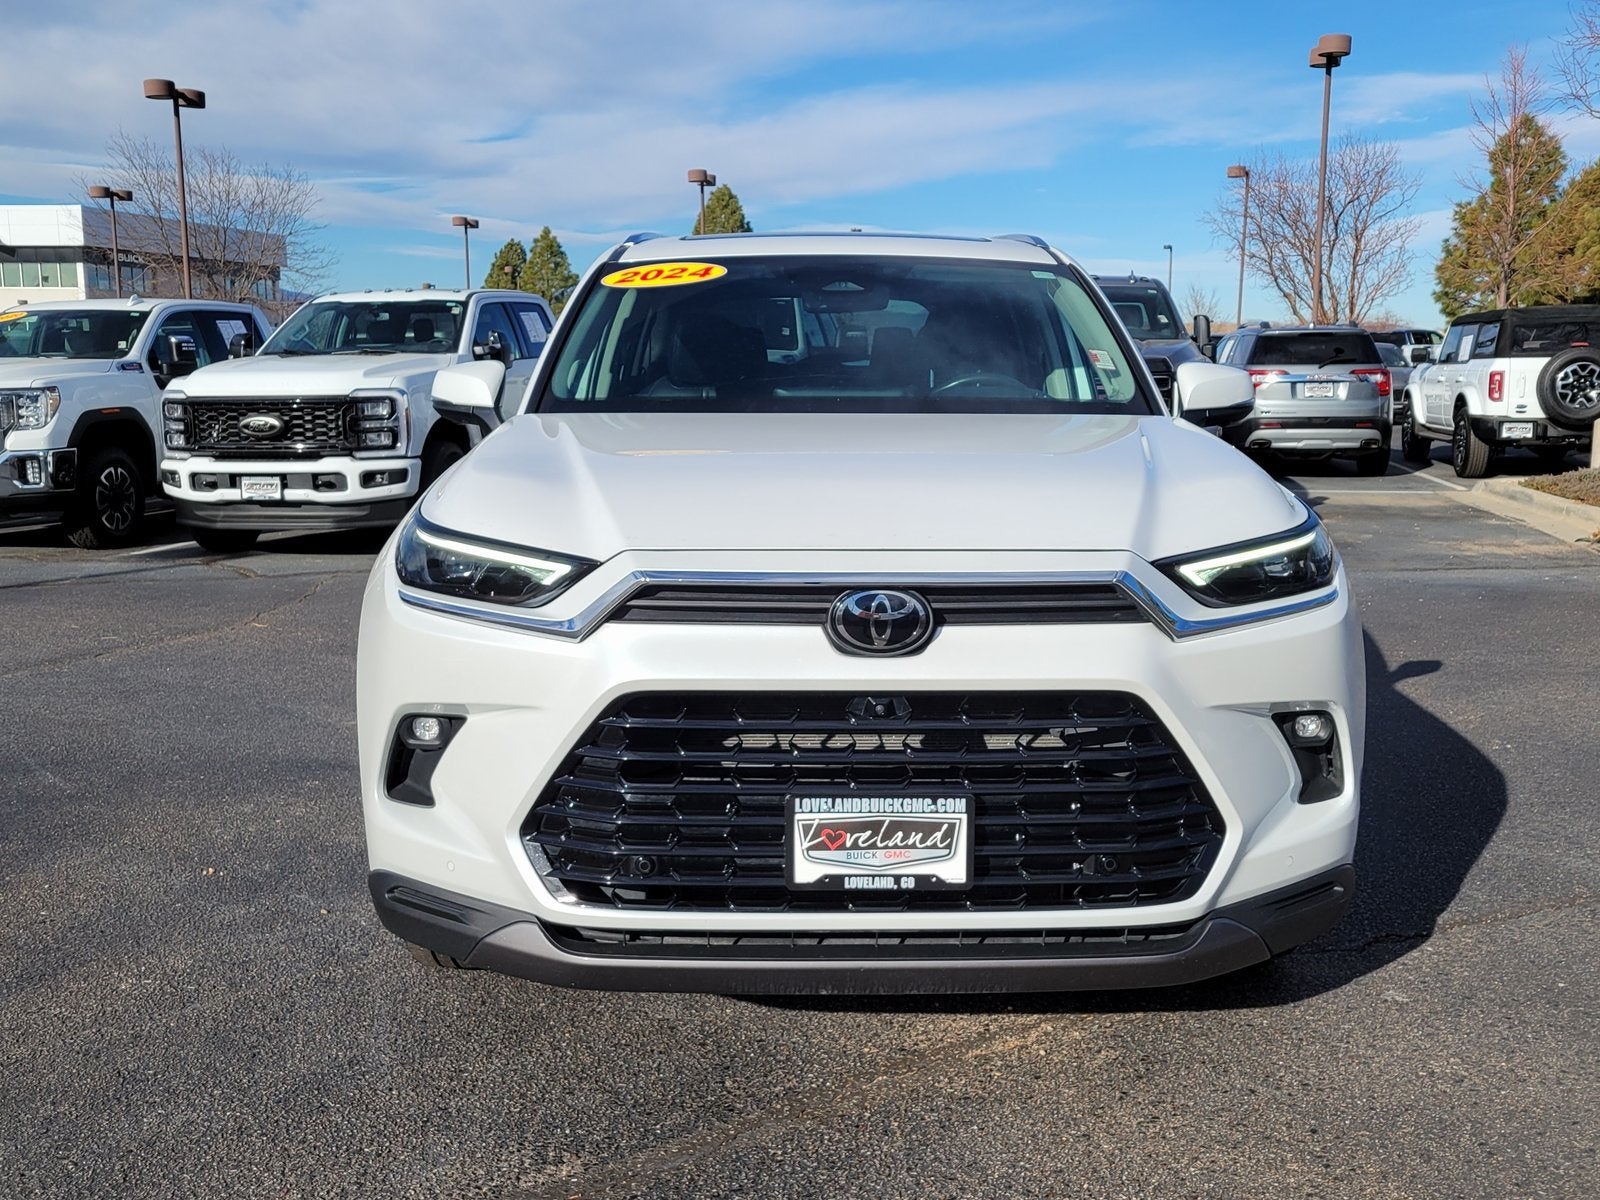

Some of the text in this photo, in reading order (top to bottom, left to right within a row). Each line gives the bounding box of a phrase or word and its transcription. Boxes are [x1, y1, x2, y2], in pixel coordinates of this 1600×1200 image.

[613, 266, 715, 284] 2024
[248, 420, 271, 431] Ford
[846, 850, 912, 860] BUICK GMC
[844, 876, 915, 889] LOVELAND, CO
